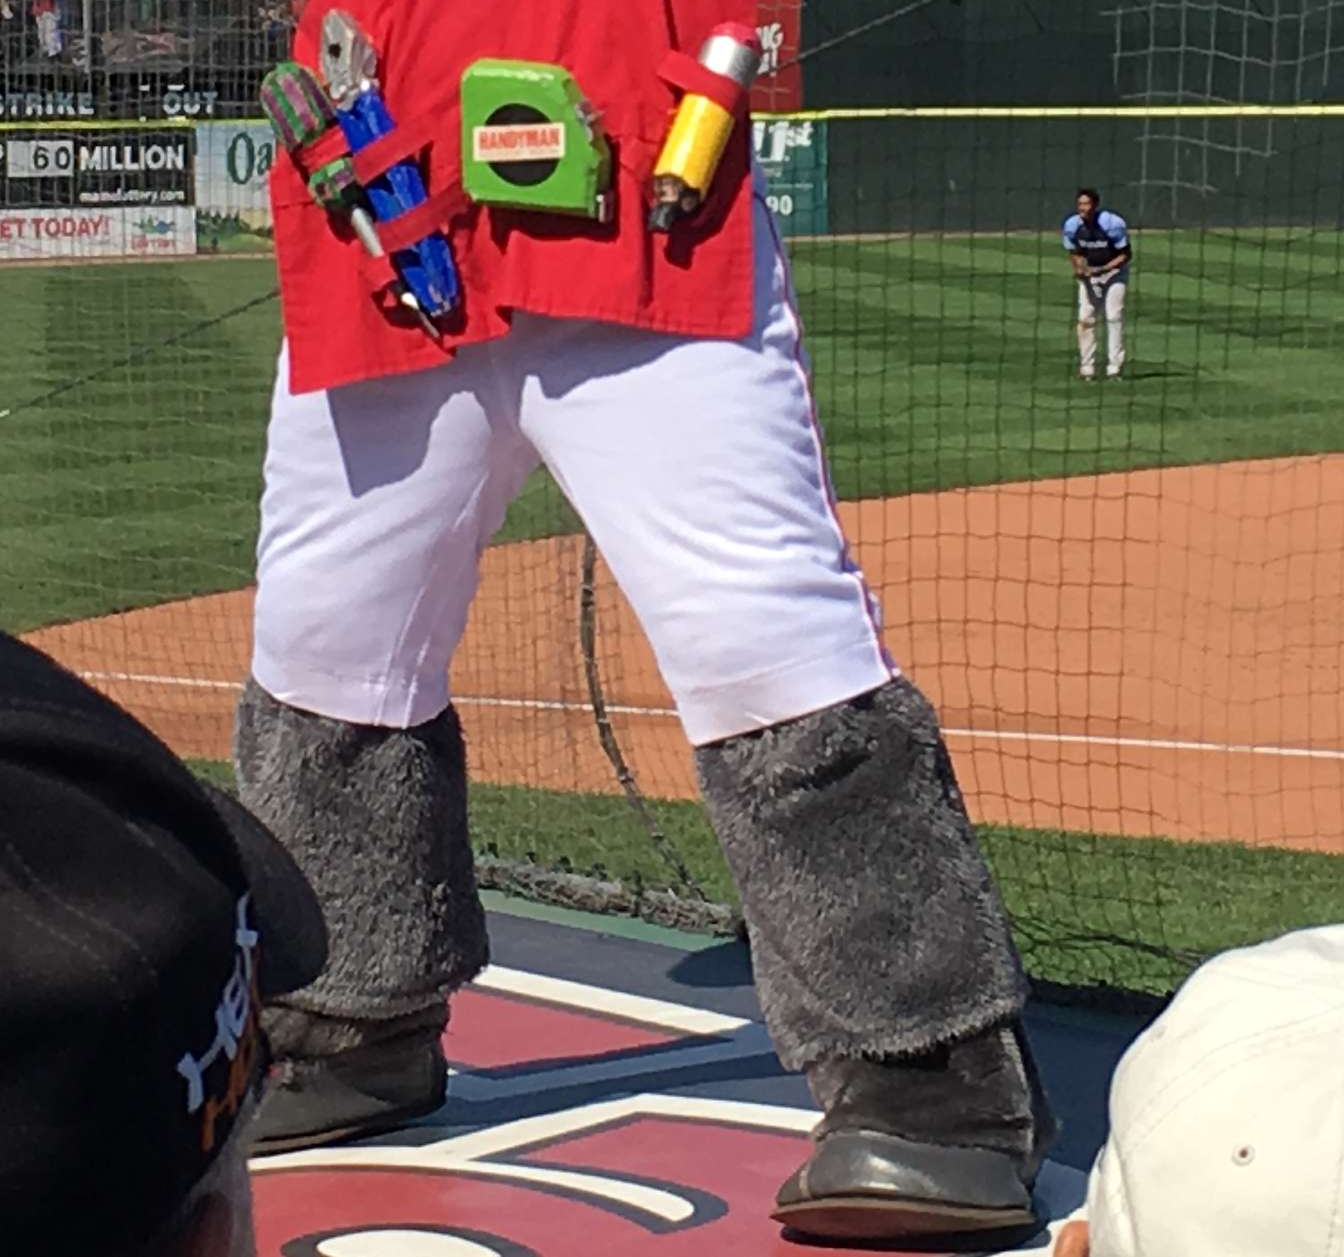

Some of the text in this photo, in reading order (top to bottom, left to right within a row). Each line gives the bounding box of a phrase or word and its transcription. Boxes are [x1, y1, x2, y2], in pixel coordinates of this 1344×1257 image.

[163, 91, 218, 115] OUT
[478, 128, 561, 150] HANDYMAN
[32, 145, 72, 170] 60
[79, 144, 185, 171] MILLION
[31, 214, 112, 239] TODAY!
